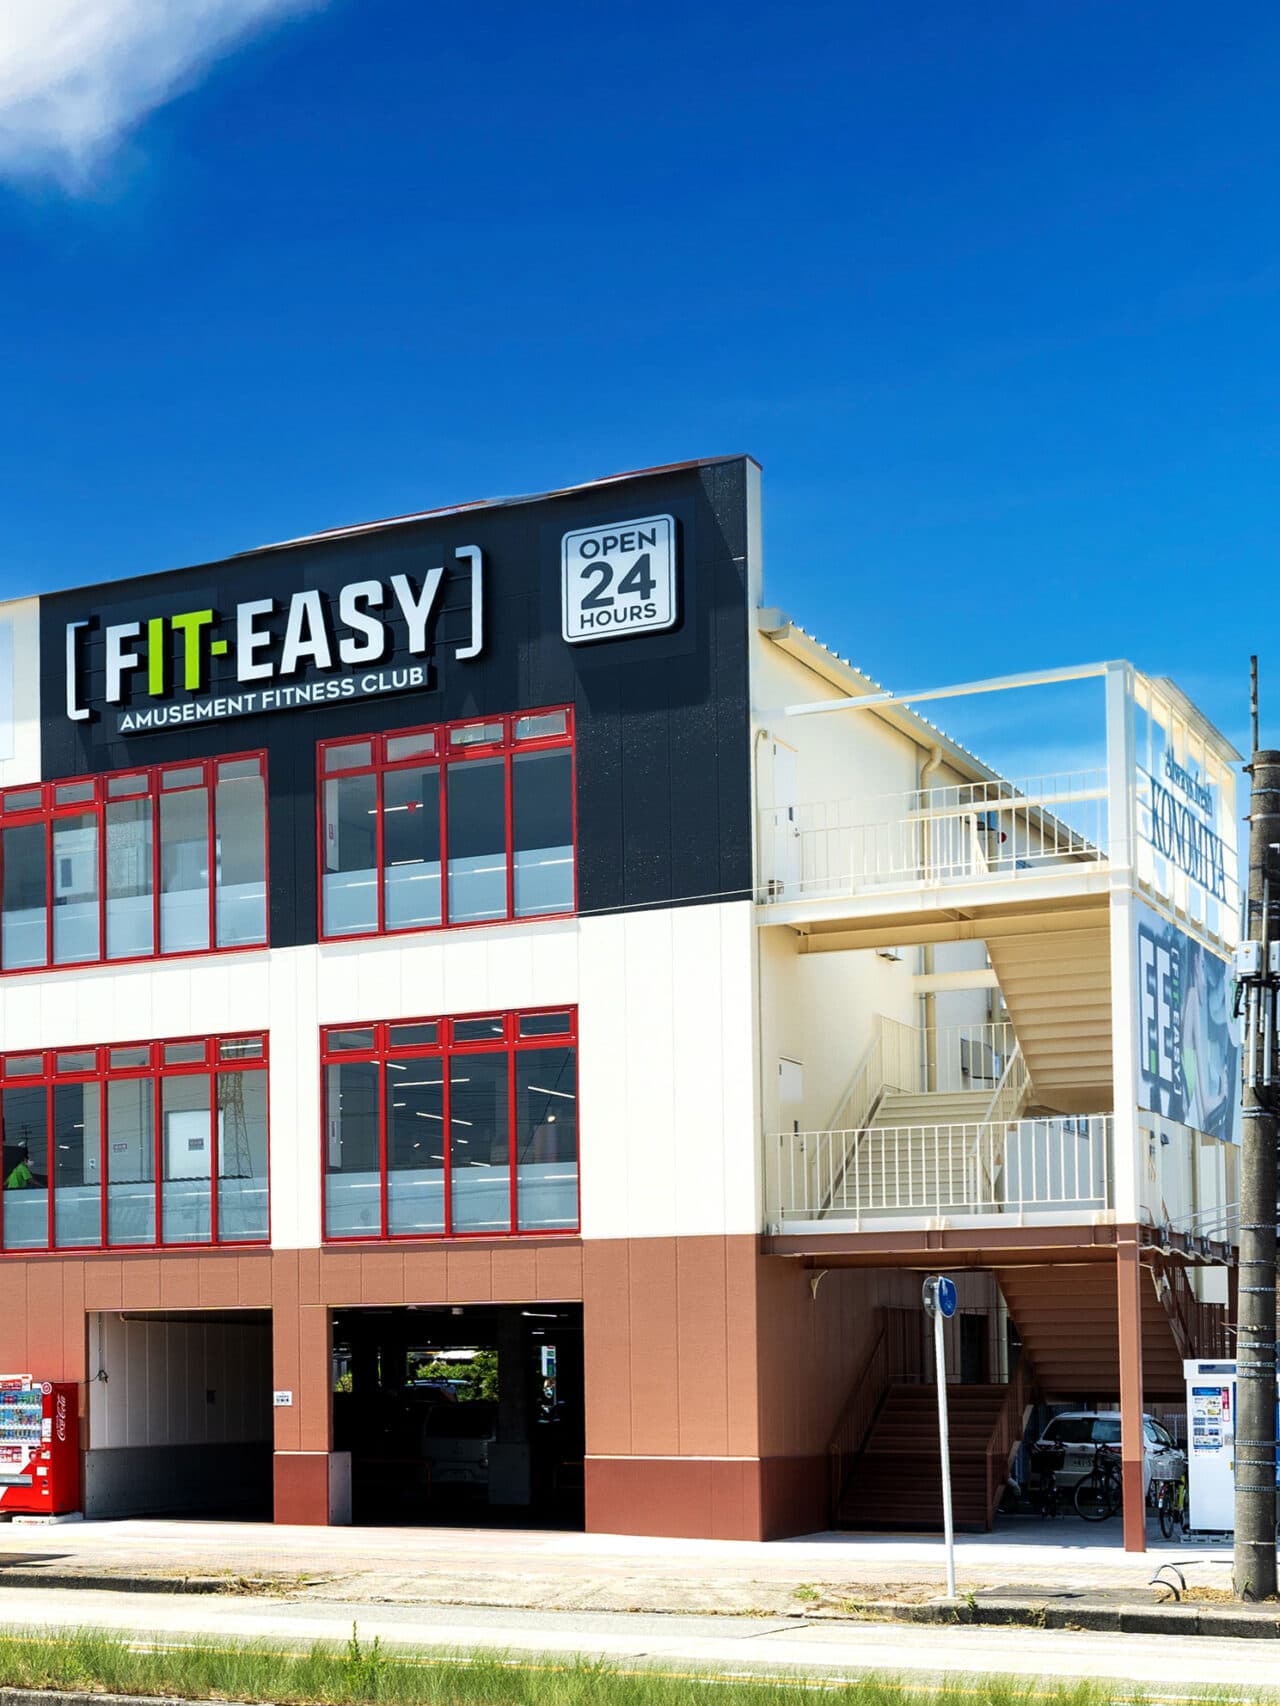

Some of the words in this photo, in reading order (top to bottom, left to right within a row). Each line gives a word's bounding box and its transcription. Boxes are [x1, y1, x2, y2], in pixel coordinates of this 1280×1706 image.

[579, 527, 657, 560] OPEN
[579, 554, 657, 611] 24
[579, 602, 657, 629] HOURS
[120, 693, 256, 732] AMUSEMENT
[261, 680, 355, 708] FITNESS
[361, 667, 425, 693] CLUB
[1150, 776, 1227, 904] KONOMIYA
